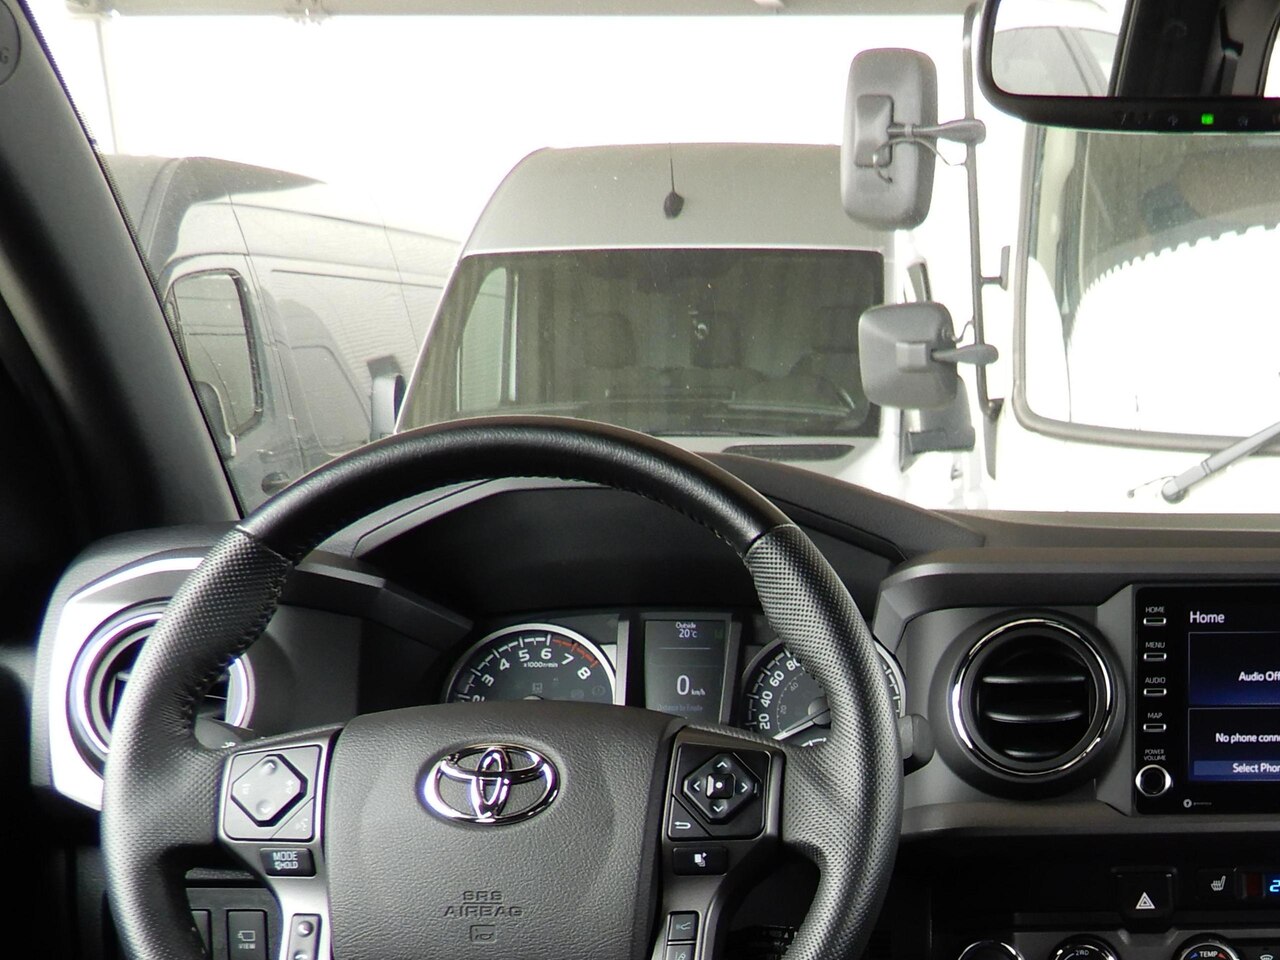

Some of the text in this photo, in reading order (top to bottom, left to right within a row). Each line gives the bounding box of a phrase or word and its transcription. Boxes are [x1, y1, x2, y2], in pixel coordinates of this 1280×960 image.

[1189, 611, 1225, 623] Home
[519, 649, 530, 661] 5
[541, 648, 552, 660] 6
[561, 653, 574, 665] 7
[499, 658, 510, 671] 4
[577, 667, 591, 680] 8
[769, 671, 784, 687] 60
[1238, 671, 1265, 681] Audio
[481, 674, 494, 686] 3
[676, 674, 690, 695] 0
[760, 691, 773, 707] 40
[759, 713, 770, 730] 20
[1216, 733, 1229, 742] No
[1230, 733, 1257, 744] phone
[1232, 763, 1259, 773] Select
[273, 851, 297, 861] MODE
[463, 890, 502, 901] SRS
[443, 905, 522, 917] AIRBAG
[1199, 950, 1218, 958] TEMP
